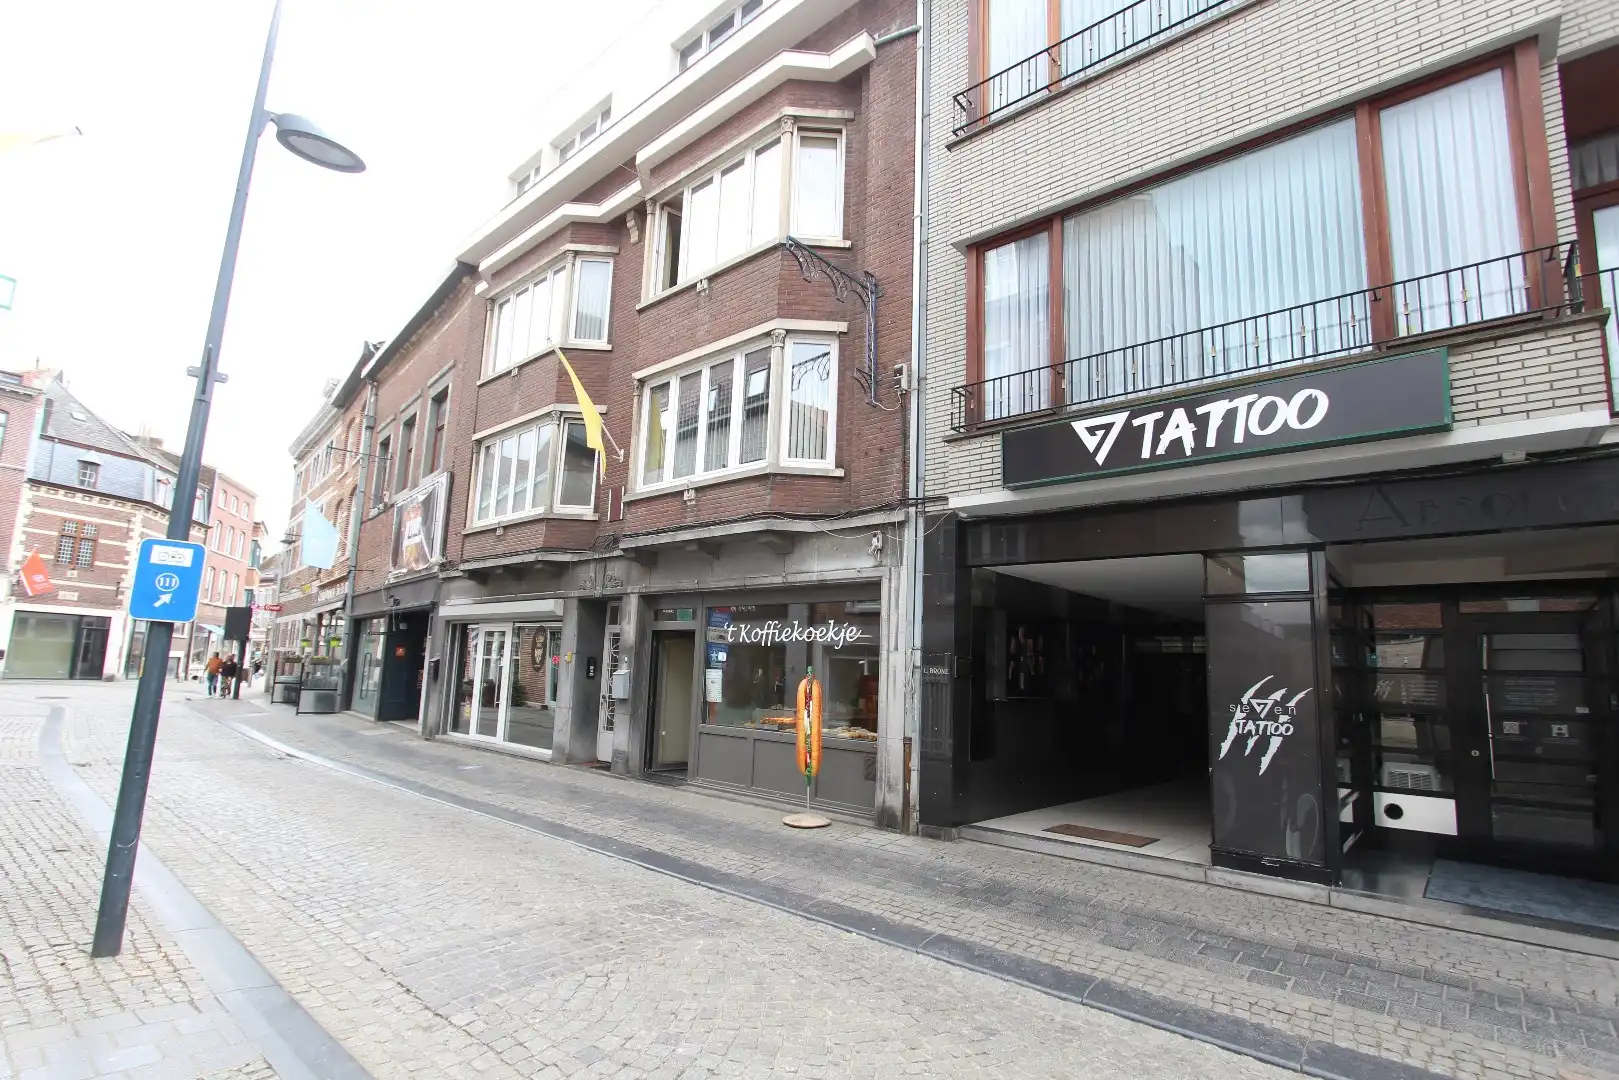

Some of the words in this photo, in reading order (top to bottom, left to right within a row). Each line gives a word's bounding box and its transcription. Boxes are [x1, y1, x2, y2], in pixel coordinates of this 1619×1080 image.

[1132, 388, 1329, 459] TATTOO
[158, 577, 176, 587] 111
[739, 619, 862, 650] Koffiekoekje
[1235, 719, 1294, 736] TATTOO
